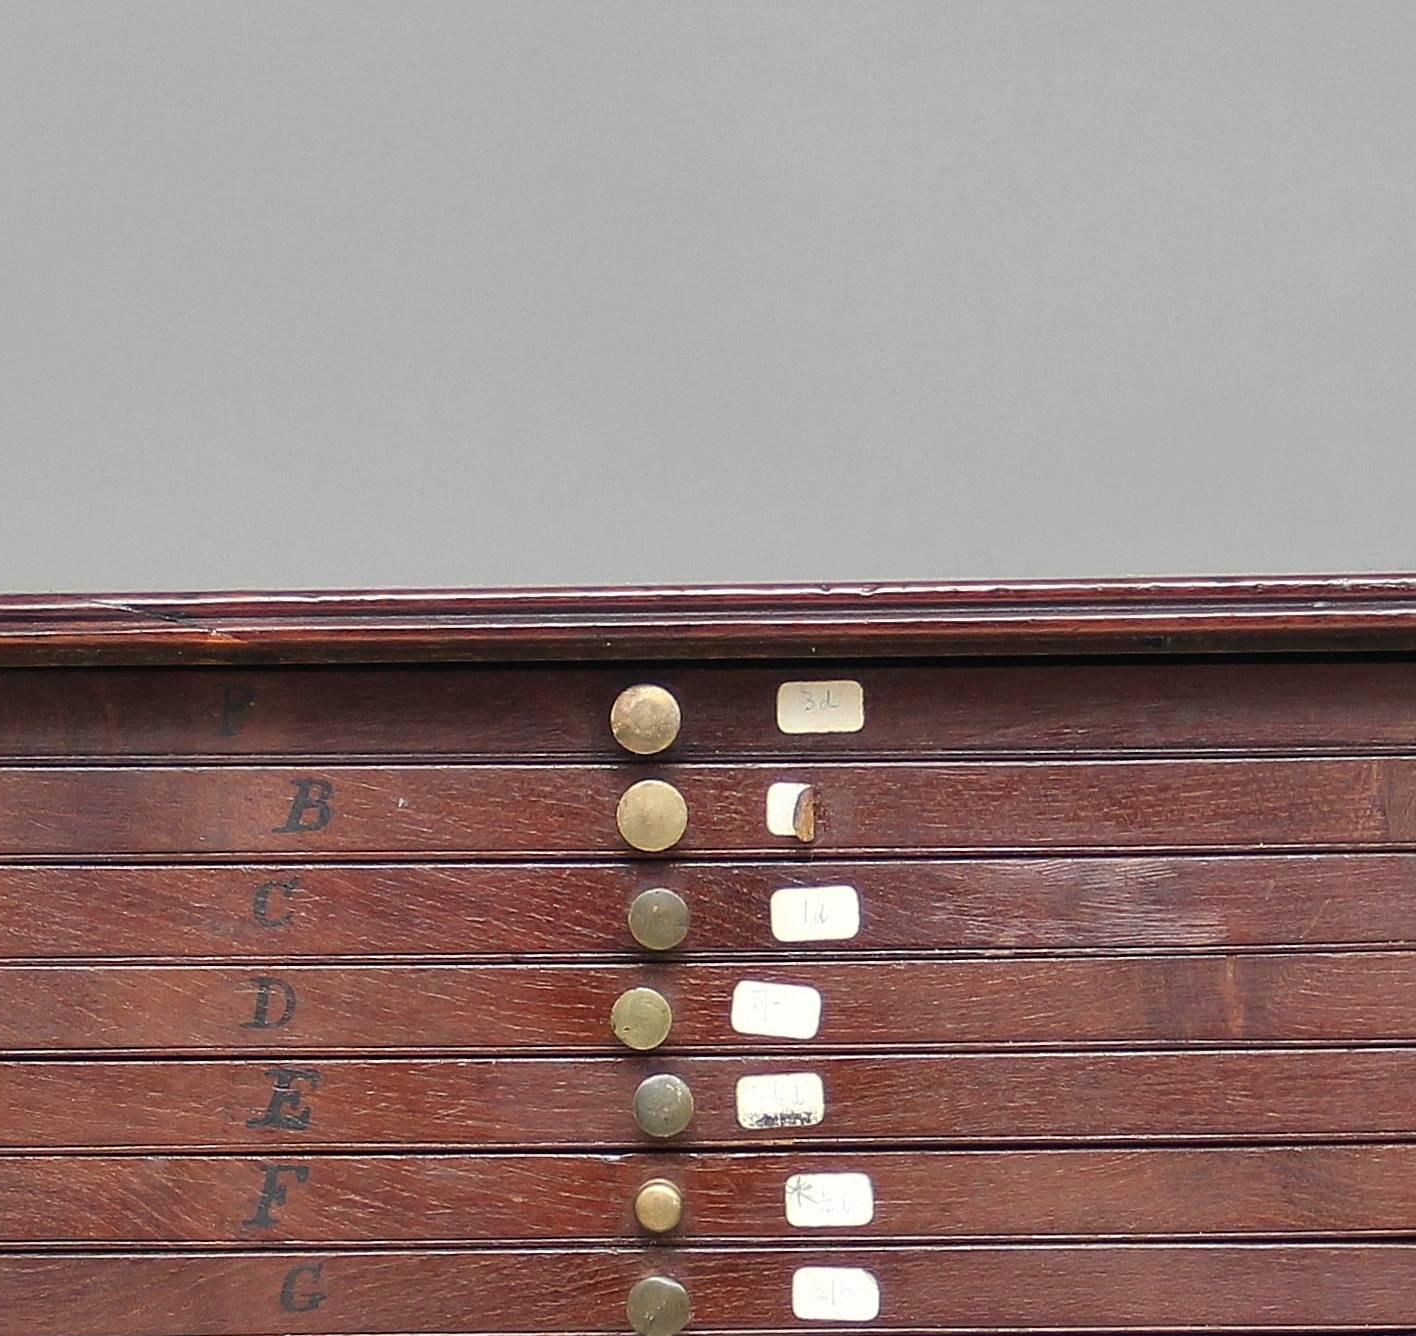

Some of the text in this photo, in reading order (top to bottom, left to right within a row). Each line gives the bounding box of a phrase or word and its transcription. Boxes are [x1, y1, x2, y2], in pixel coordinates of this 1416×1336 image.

[274, 778, 332, 834] B
[256, 875, 299, 928] C
[242, 977, 295, 1029] D
[248, 1068, 315, 1131] E
[243, 1164, 309, 1228] F
[283, 1262, 327, 1313] G
